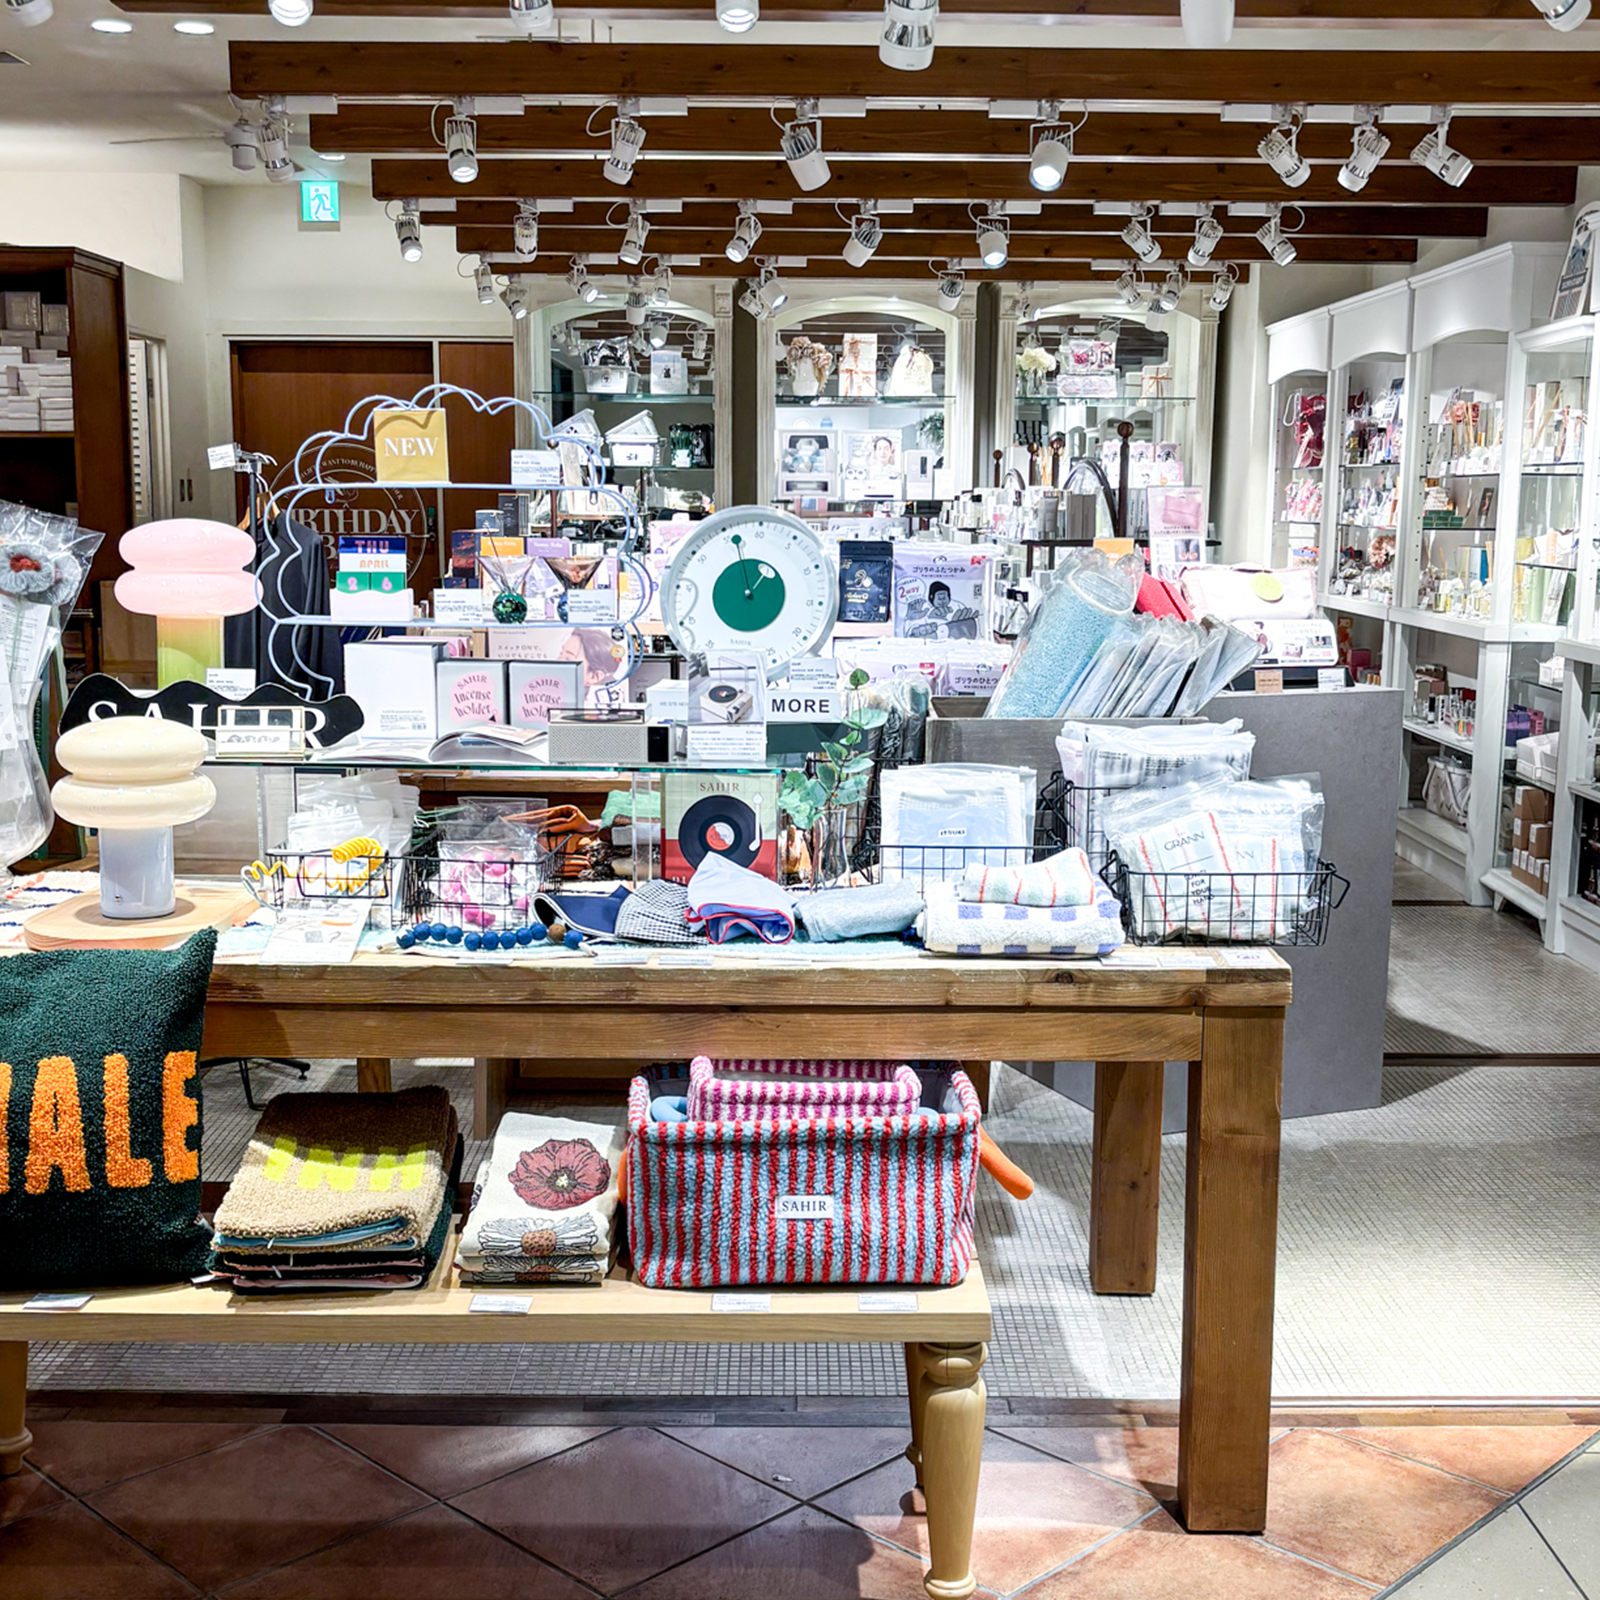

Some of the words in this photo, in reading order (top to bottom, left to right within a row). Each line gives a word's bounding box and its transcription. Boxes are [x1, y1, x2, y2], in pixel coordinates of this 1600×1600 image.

[384, 437, 438, 457] NEW
[287, 508, 420, 534] IRTHDAY
[354, 540, 389, 553] THU
[359, 559, 389, 569] APRIL
[346, 576, 358, 592] 2
[381, 576, 393, 592] 6
[457, 675, 488, 690] SAHIR
[528, 679, 560, 691] SAHIR
[954, 676, 999, 684] ゴリラのひとつ
[454, 691, 491, 704] Incense
[523, 693, 561, 705] Incense
[454, 702, 491, 718] holder
[771, 698, 830, 714] MORE
[699, 782, 740, 792] SAHIR
[781, 1200, 827, 1212] SAHIR
